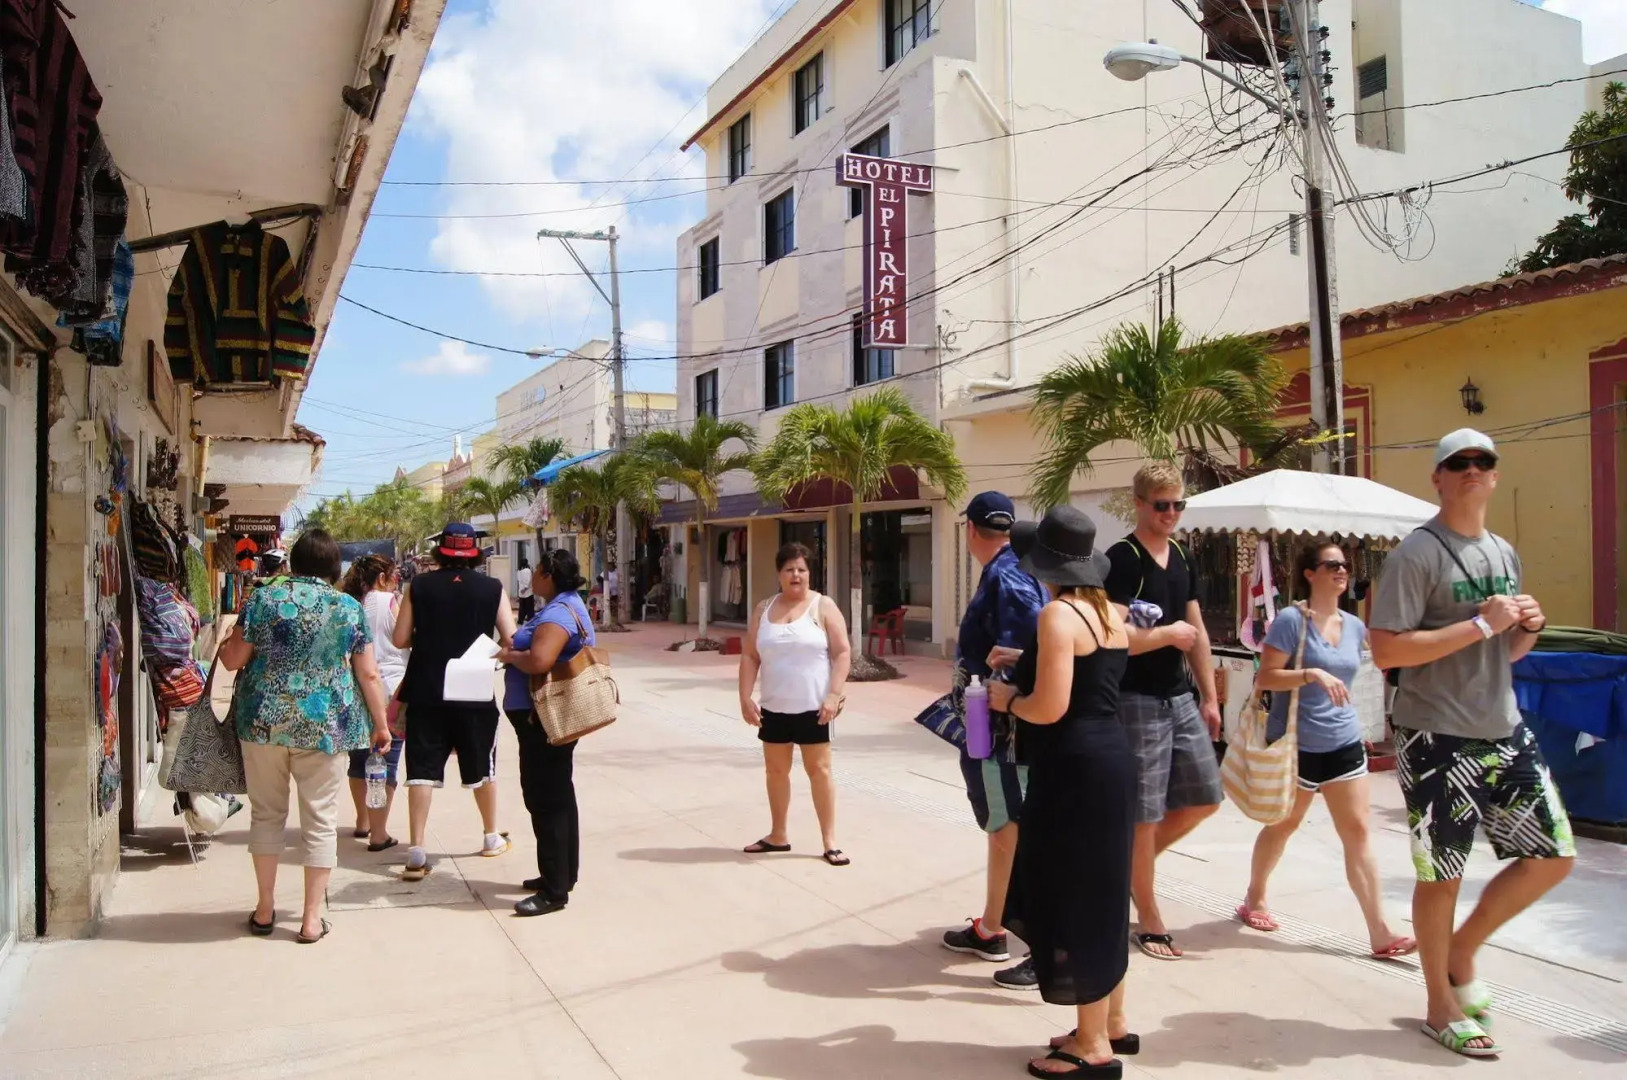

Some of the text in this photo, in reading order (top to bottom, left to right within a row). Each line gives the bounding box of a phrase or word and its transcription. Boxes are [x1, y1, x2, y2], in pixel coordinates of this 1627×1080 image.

[847, 158, 930, 186] HOTEL
[879, 187, 900, 203] EL
[875, 207, 905, 340] PIRATA
